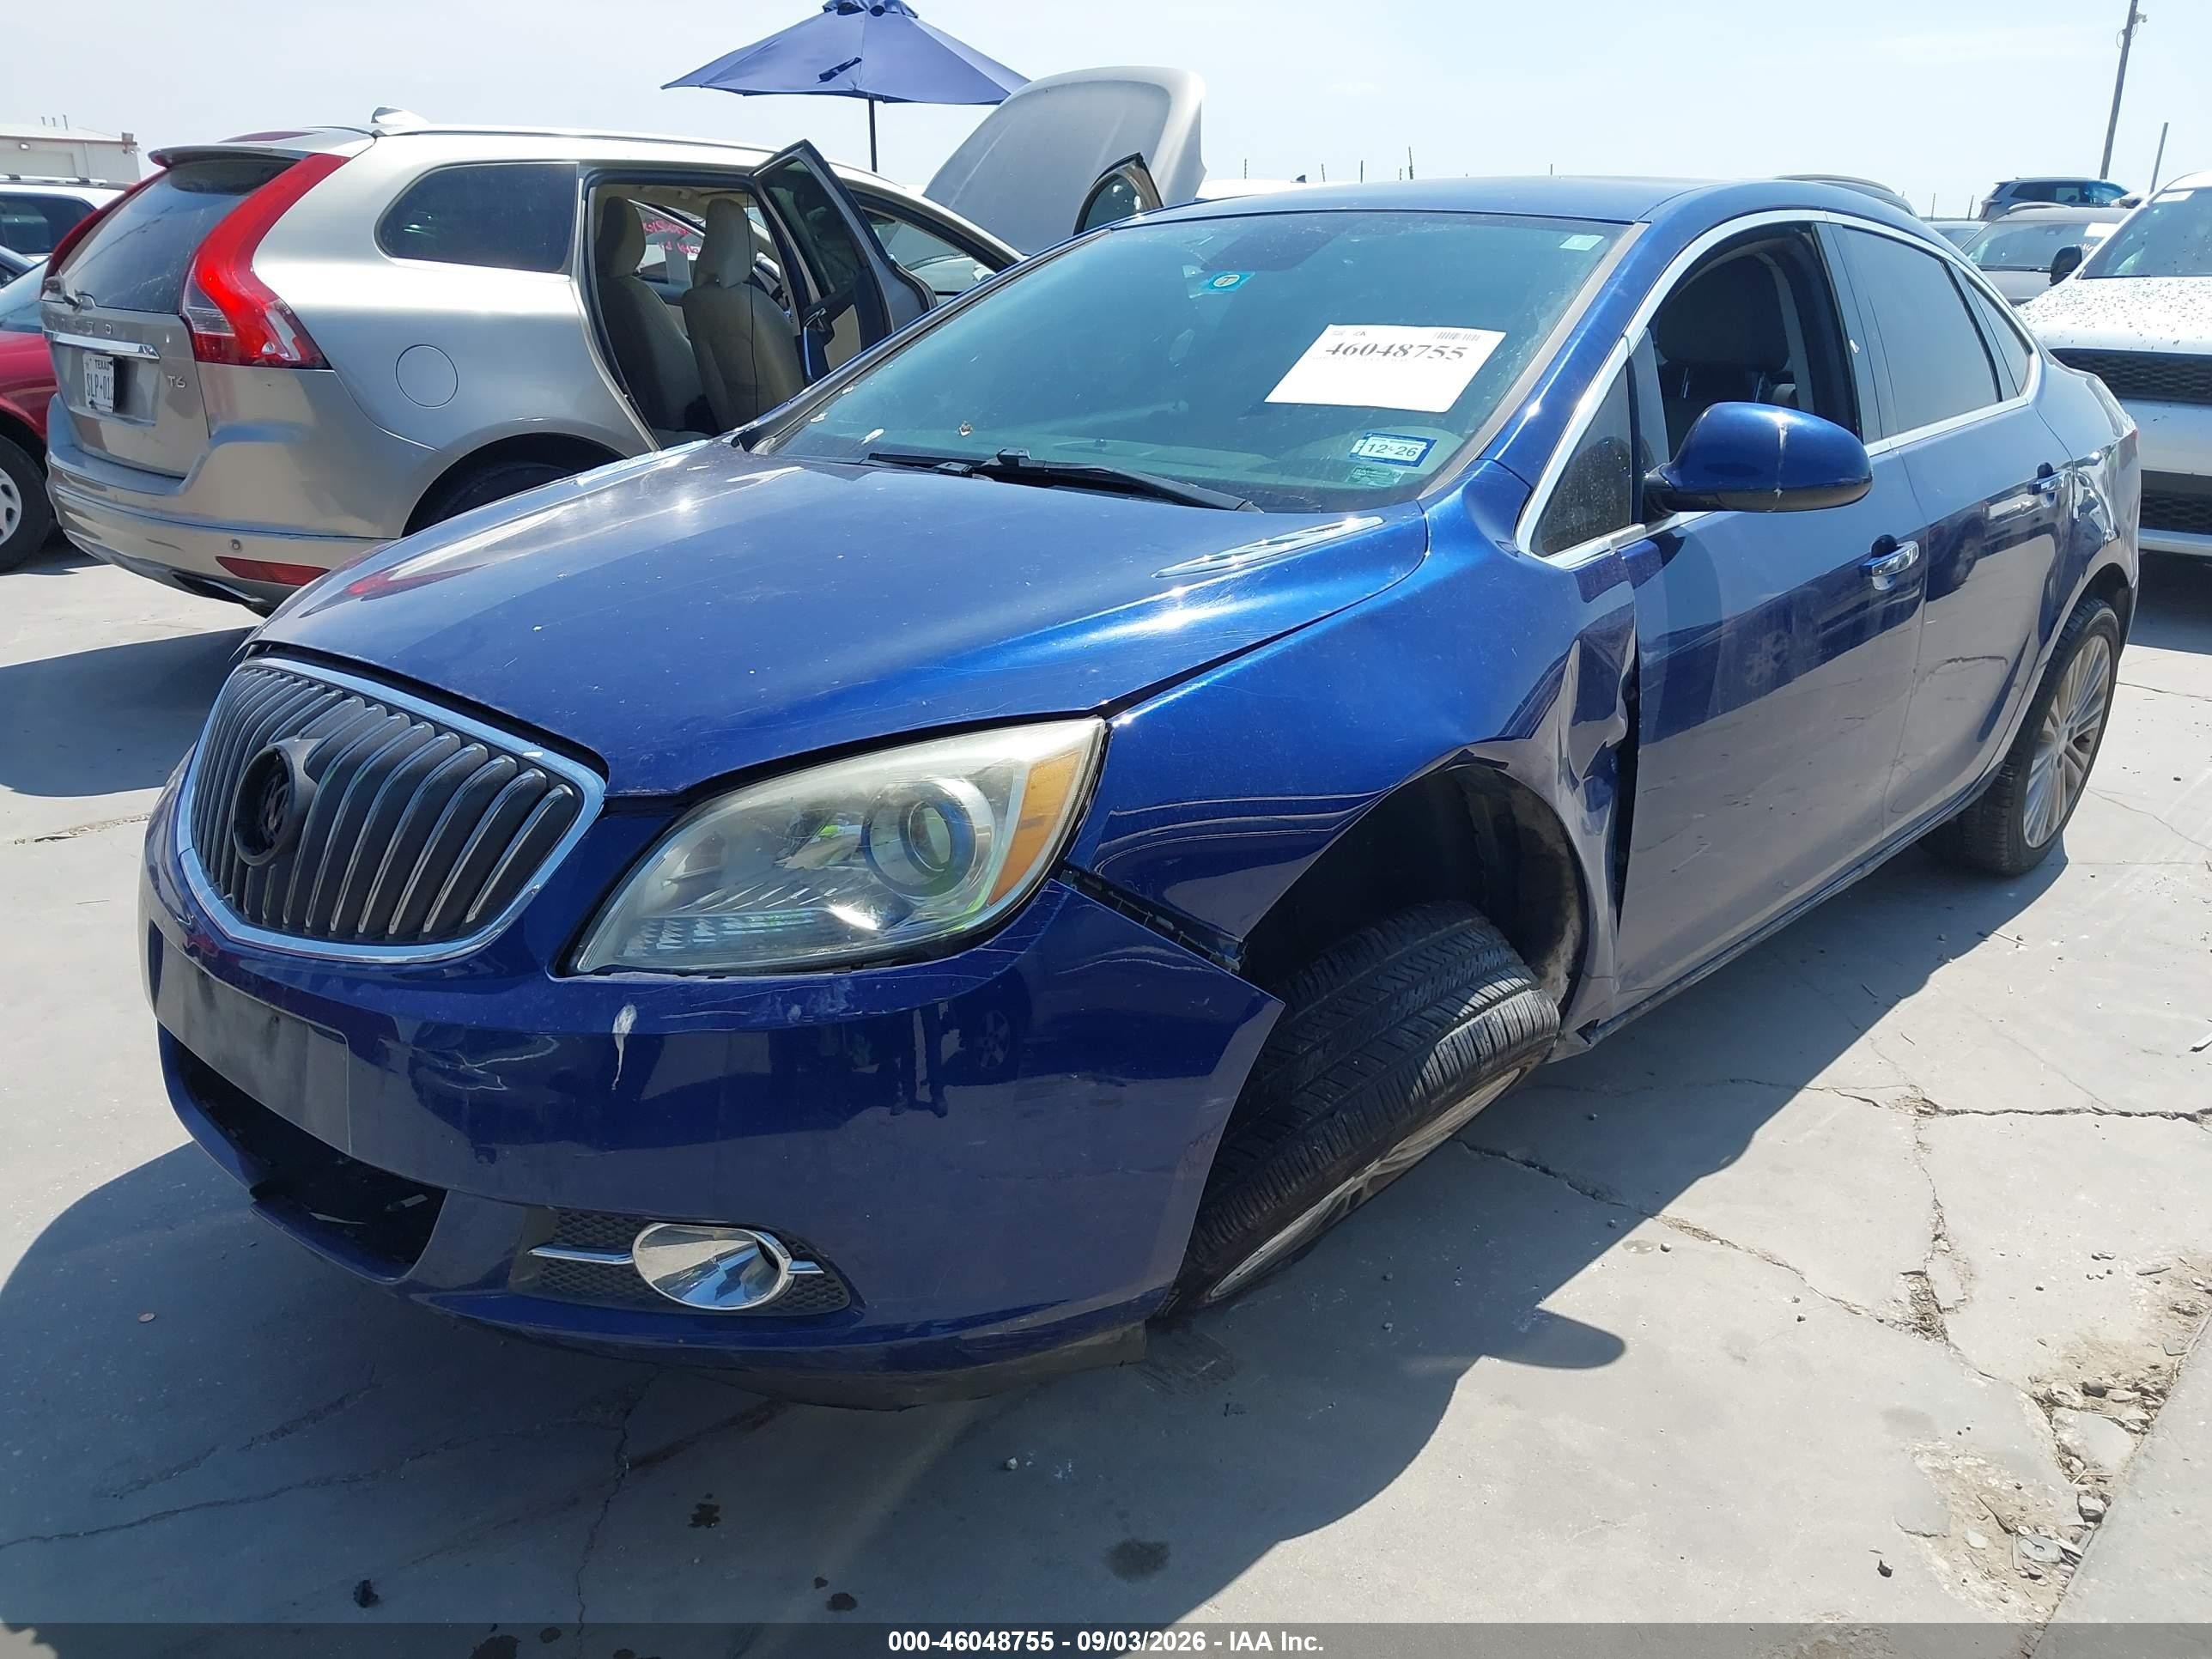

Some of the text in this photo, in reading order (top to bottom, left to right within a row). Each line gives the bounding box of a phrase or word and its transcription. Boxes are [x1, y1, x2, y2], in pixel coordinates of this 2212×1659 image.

[1325, 342, 1468, 361] 46048755
[94, 359, 110, 371] TEXAS
[167, 374, 186, 388] T6
